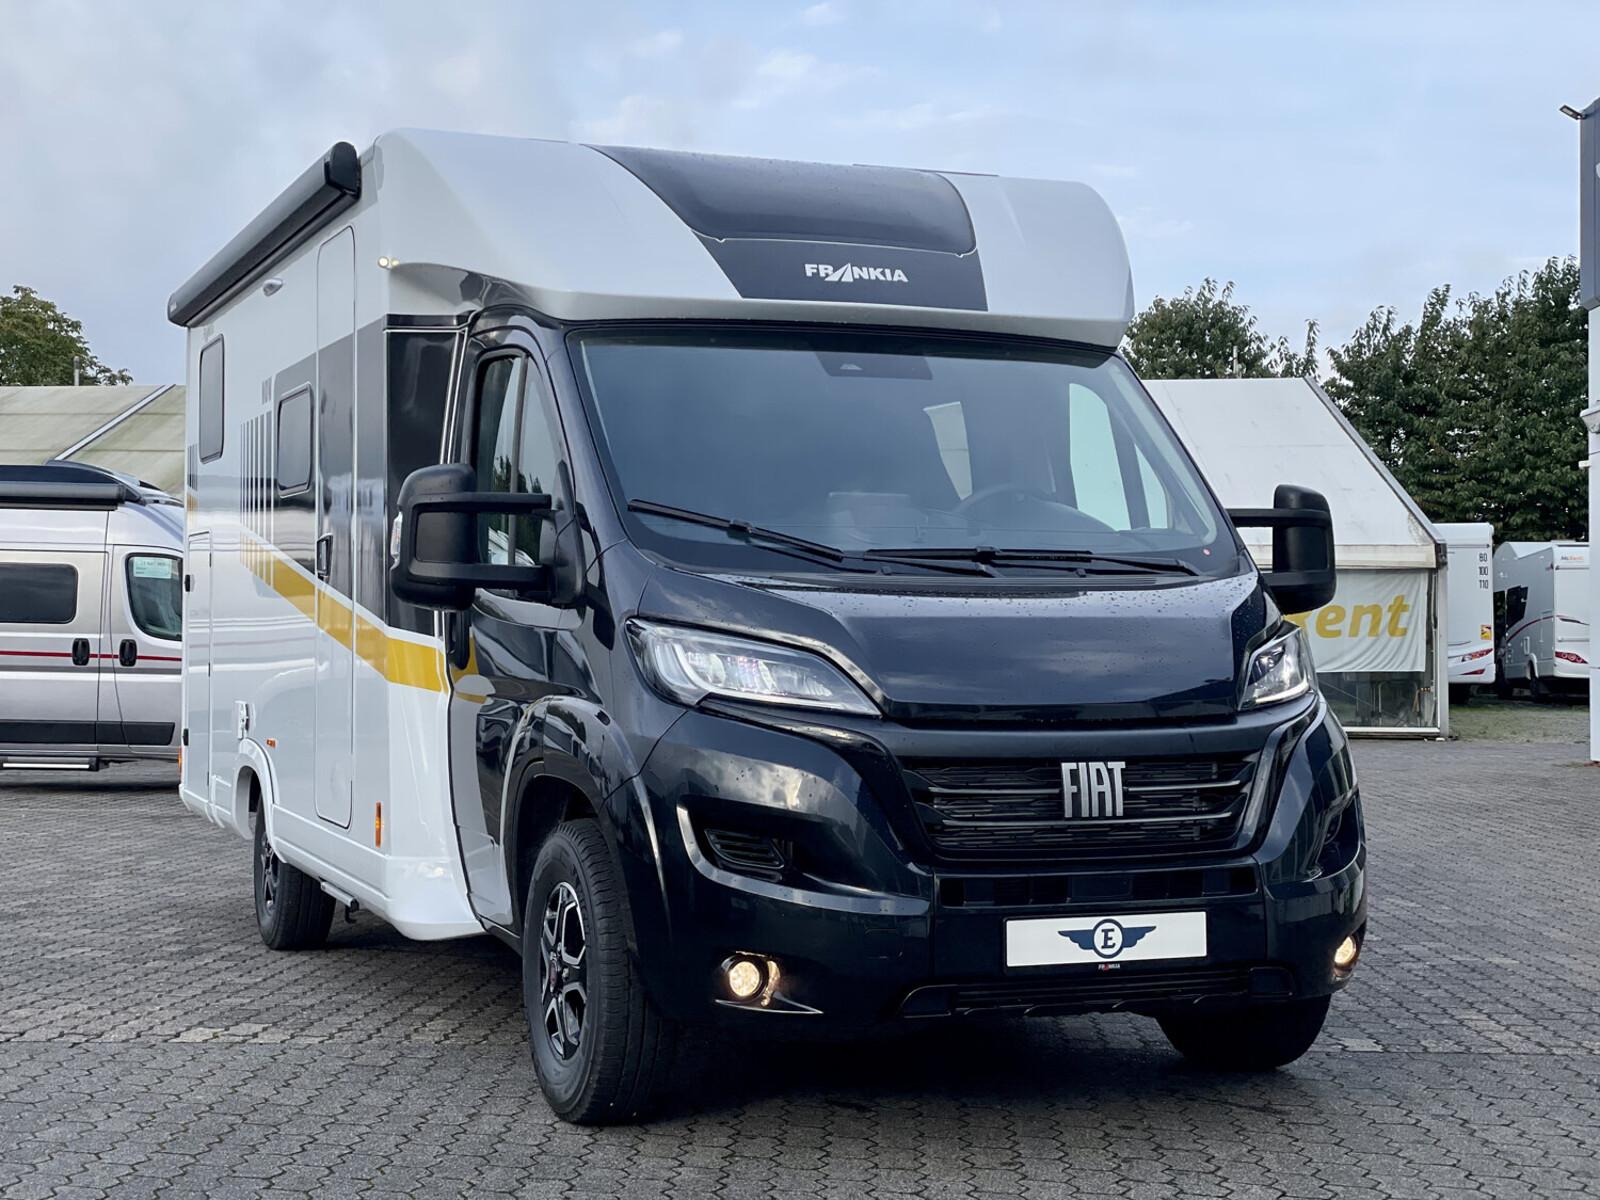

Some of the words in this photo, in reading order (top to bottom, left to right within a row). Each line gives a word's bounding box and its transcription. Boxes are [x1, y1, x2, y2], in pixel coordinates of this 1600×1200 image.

[804, 263, 909, 282] FRANKIA
[1479, 566, 1489, 576] 100
[1479, 579, 1489, 589] 110
[1061, 761, 1126, 818] FIAT
